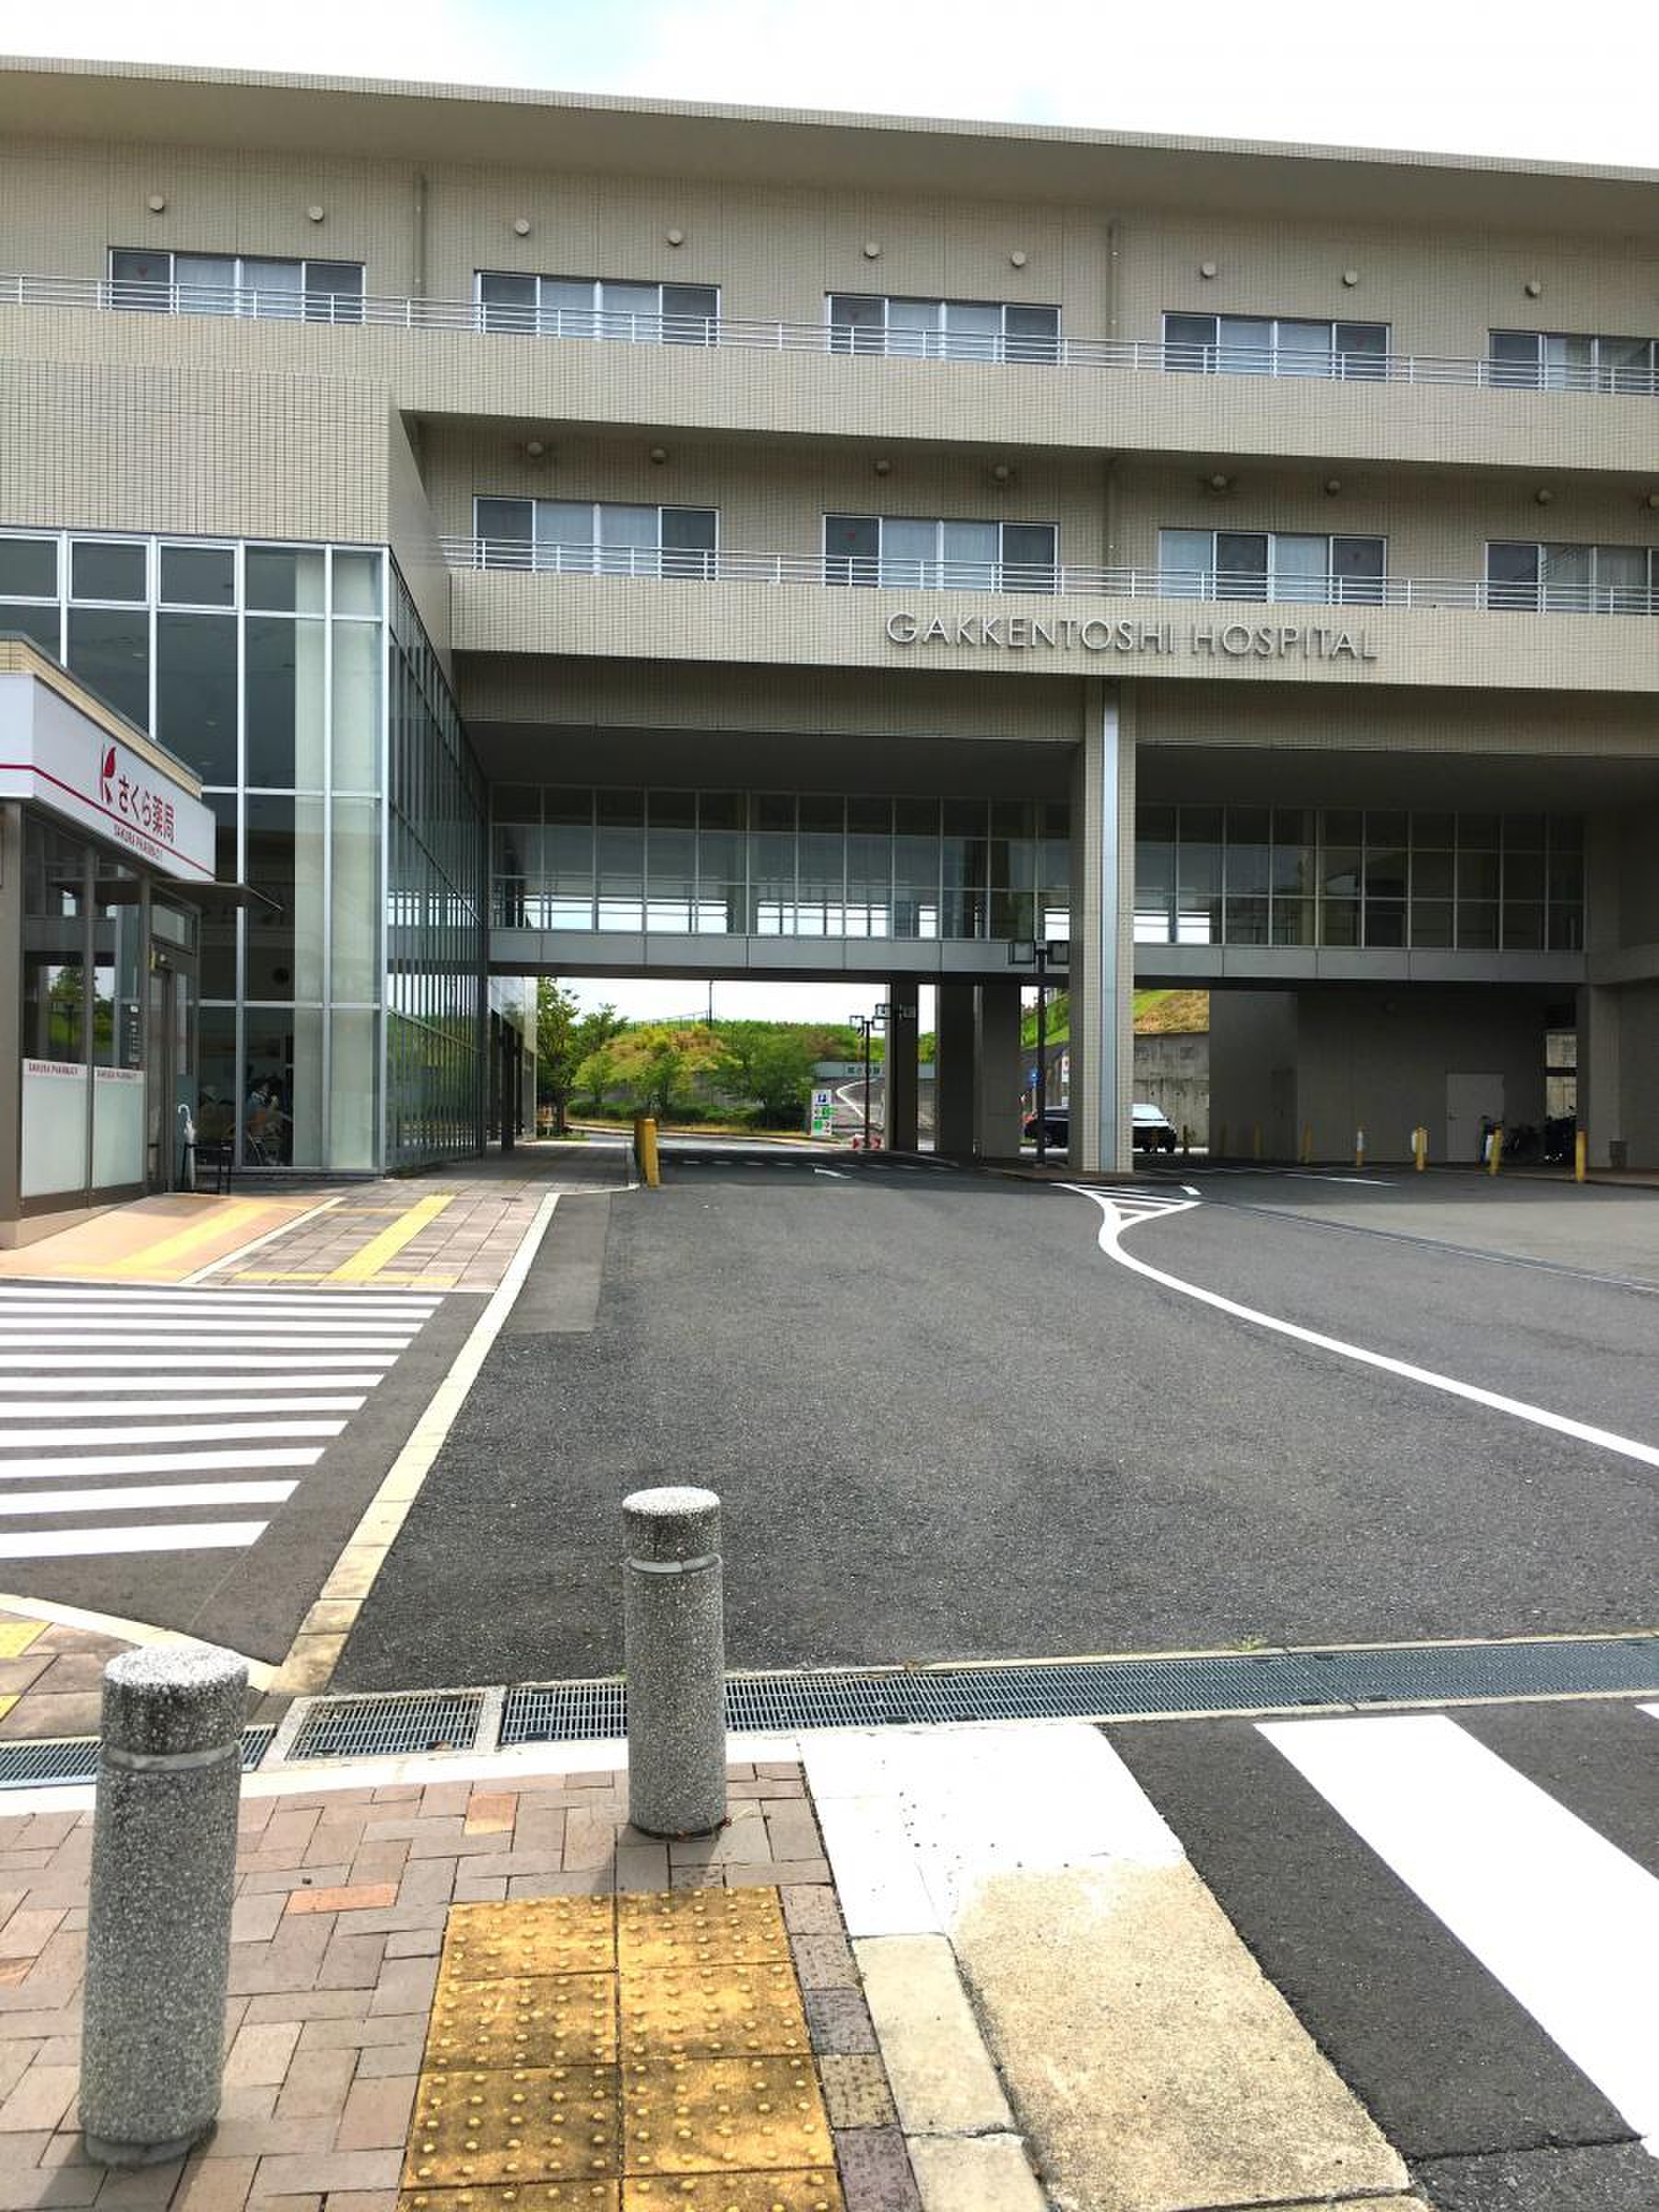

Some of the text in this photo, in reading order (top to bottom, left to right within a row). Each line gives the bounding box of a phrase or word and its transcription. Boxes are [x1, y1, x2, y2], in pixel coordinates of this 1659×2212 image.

[886, 610, 1377, 660] GAKKENTOSHI HOSPITAL
[118, 773, 175, 843] さくら薬局
